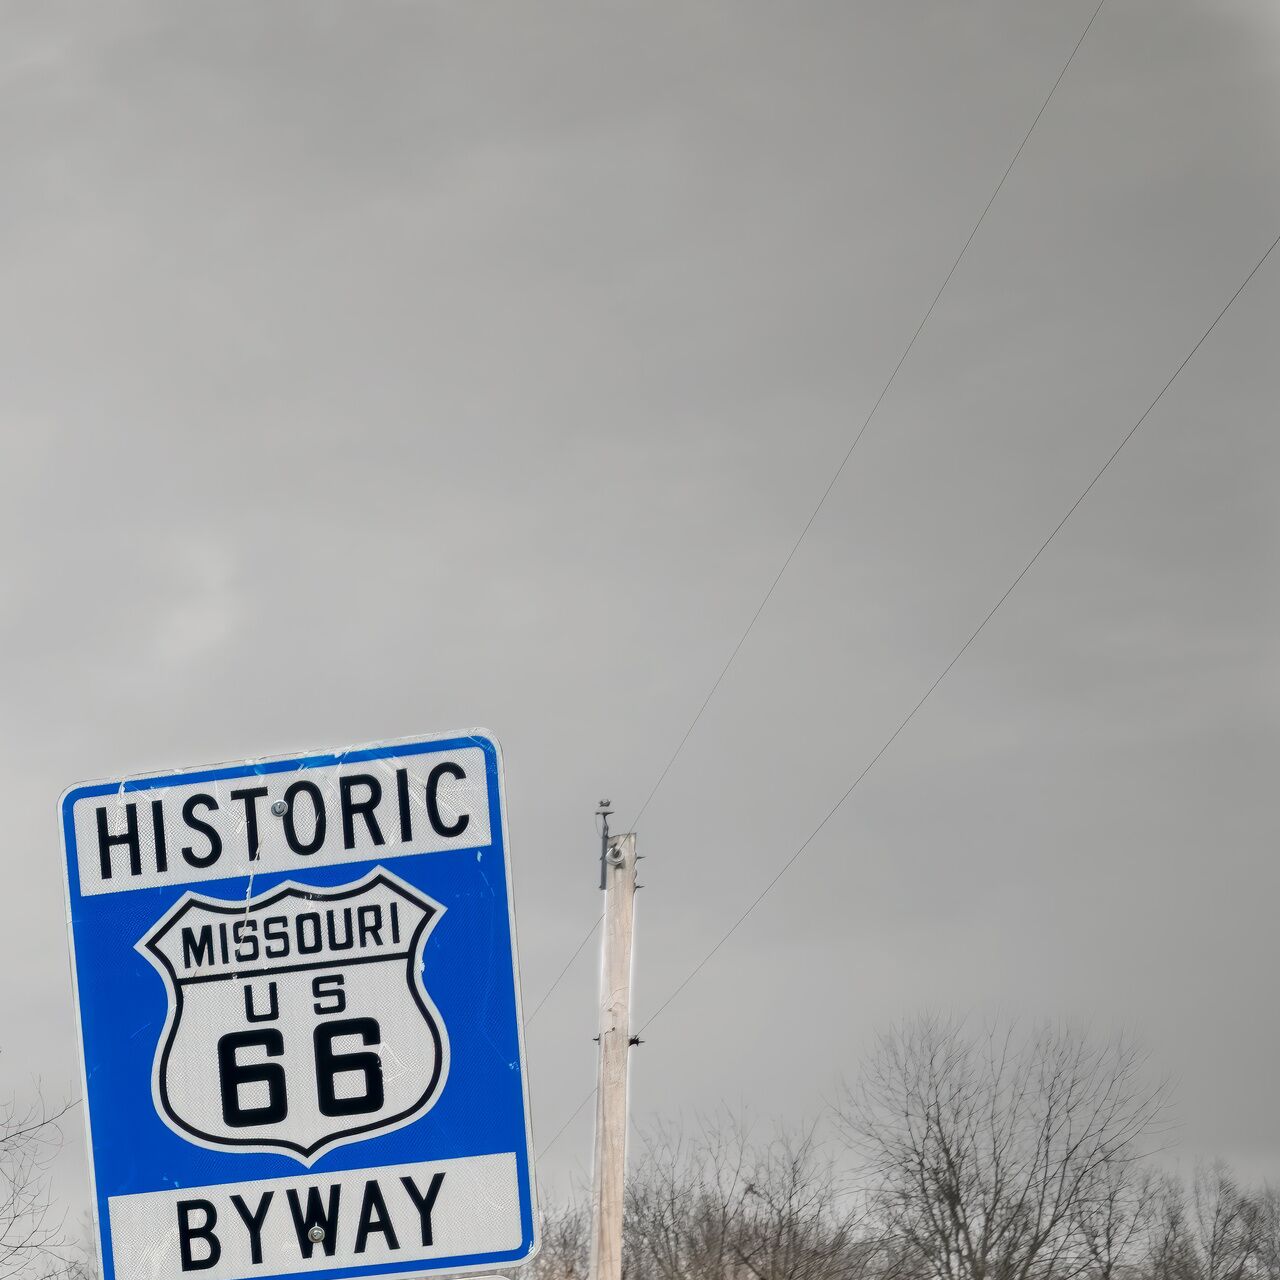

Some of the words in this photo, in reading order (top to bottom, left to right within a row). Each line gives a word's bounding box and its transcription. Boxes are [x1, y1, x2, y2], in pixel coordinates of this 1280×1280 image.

[95, 761, 470, 880] HISTORIC
[181, 901, 401, 969] MISSOURI
[217, 1016, 385, 1128] 66
[176, 1172, 446, 1272] BYWAY
